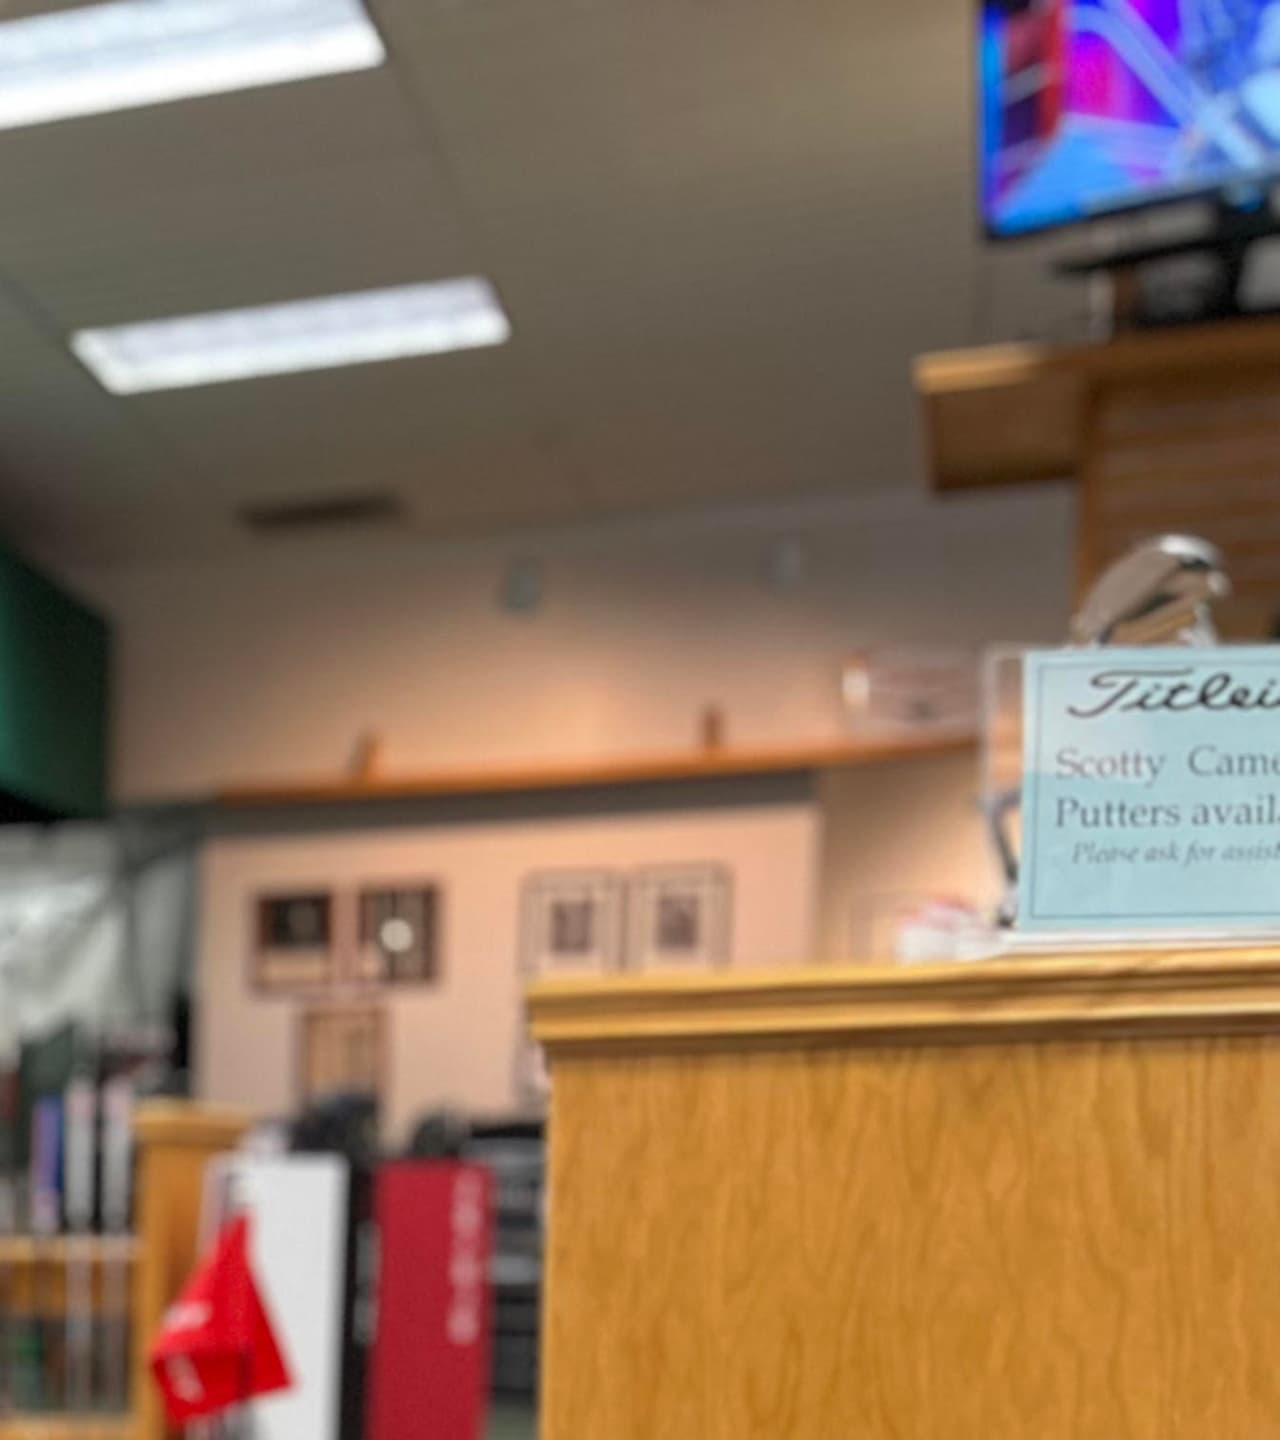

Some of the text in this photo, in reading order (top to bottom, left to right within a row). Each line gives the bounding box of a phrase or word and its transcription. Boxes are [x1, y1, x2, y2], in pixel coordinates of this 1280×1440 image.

[1055, 747, 1165, 788] Scotty
[1055, 793, 1280, 829] Putters avail
